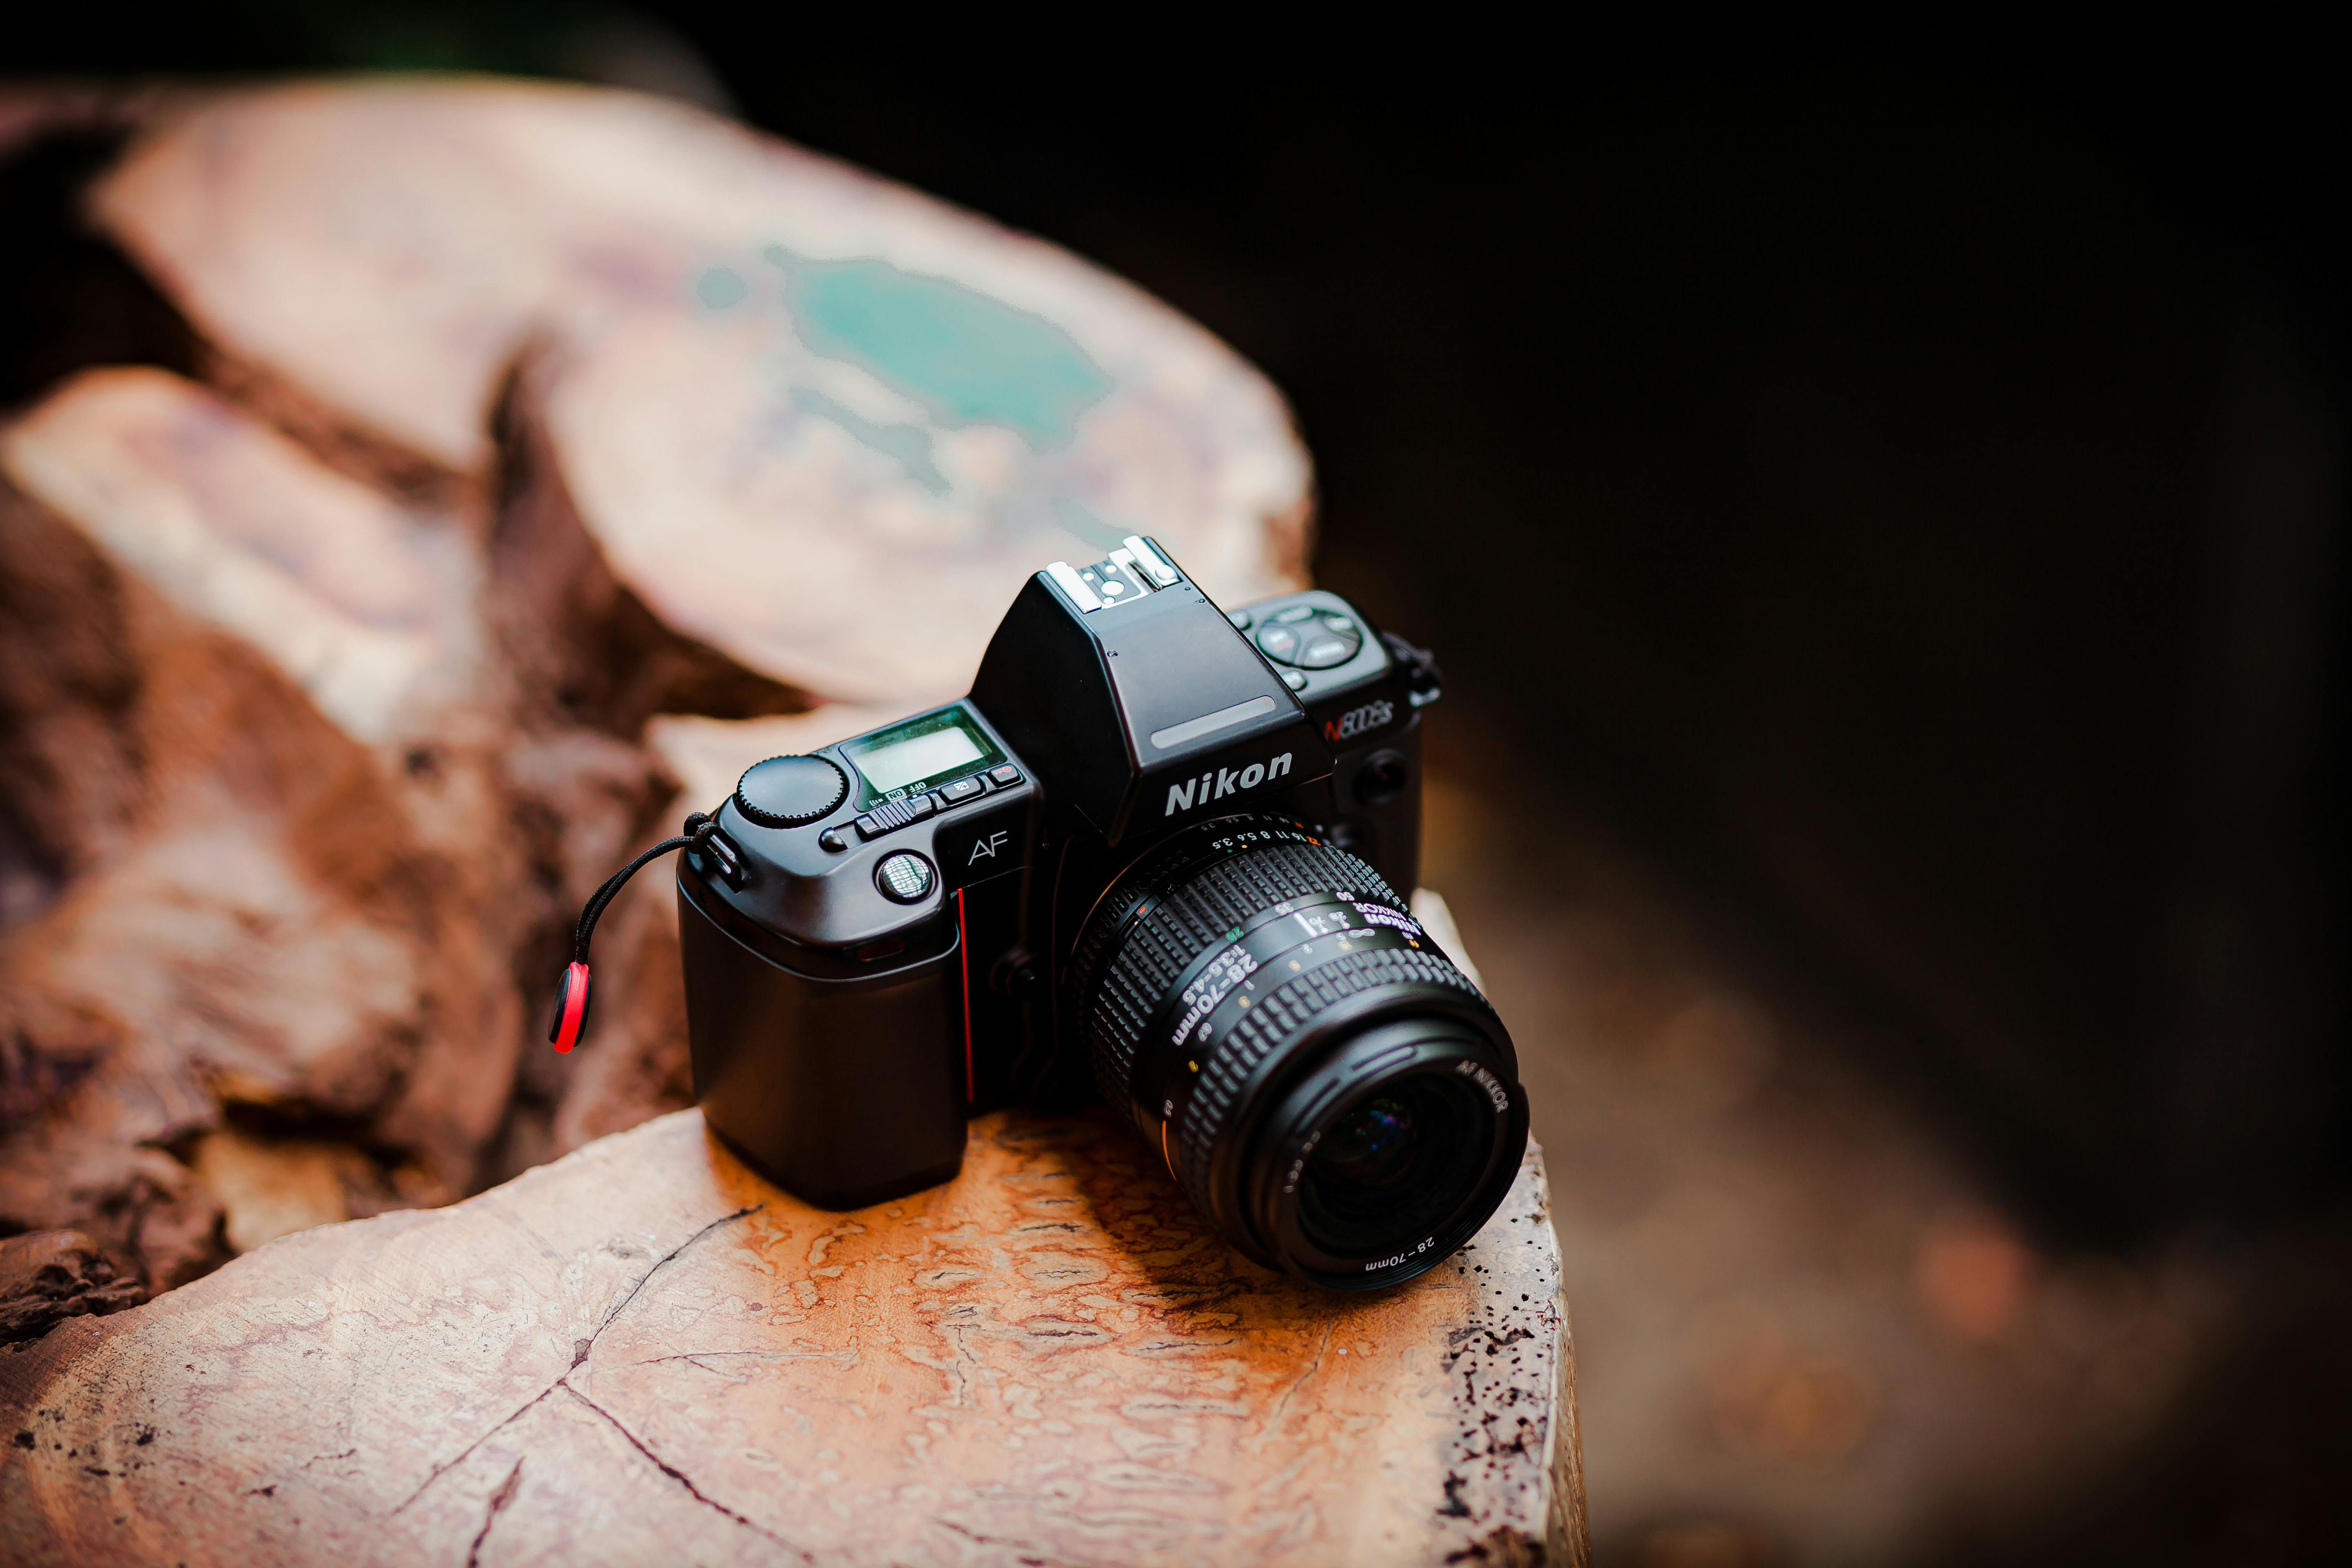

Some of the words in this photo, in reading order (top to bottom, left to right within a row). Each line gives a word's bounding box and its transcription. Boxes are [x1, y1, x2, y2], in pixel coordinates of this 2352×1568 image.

[909, 782, 926, 793] OFF
[1165, 753, 1292, 816] Nikon
[888, 790, 904, 799] ON
[1237, 832, 1257, 841] 5.6
[1260, 830, 1271, 839] 8
[1275, 830, 1290, 839] 11
[1291, 832, 1307, 841] 16
[968, 830, 1008, 866] AF
[1212, 838, 1233, 849] 3.5
[1336, 891, 1355, 901] 50
[1274, 902, 1294, 916] 35
[1352, 902, 1407, 921] NIKKOR
[1364, 913, 1421, 936] Nikon
[1225, 926, 1244, 942] 28
[1172, 954, 1258, 1045] 28-70mm
[1456, 1060, 1477, 1075] AF
[1474, 1068, 1508, 1112] NIKKOR
